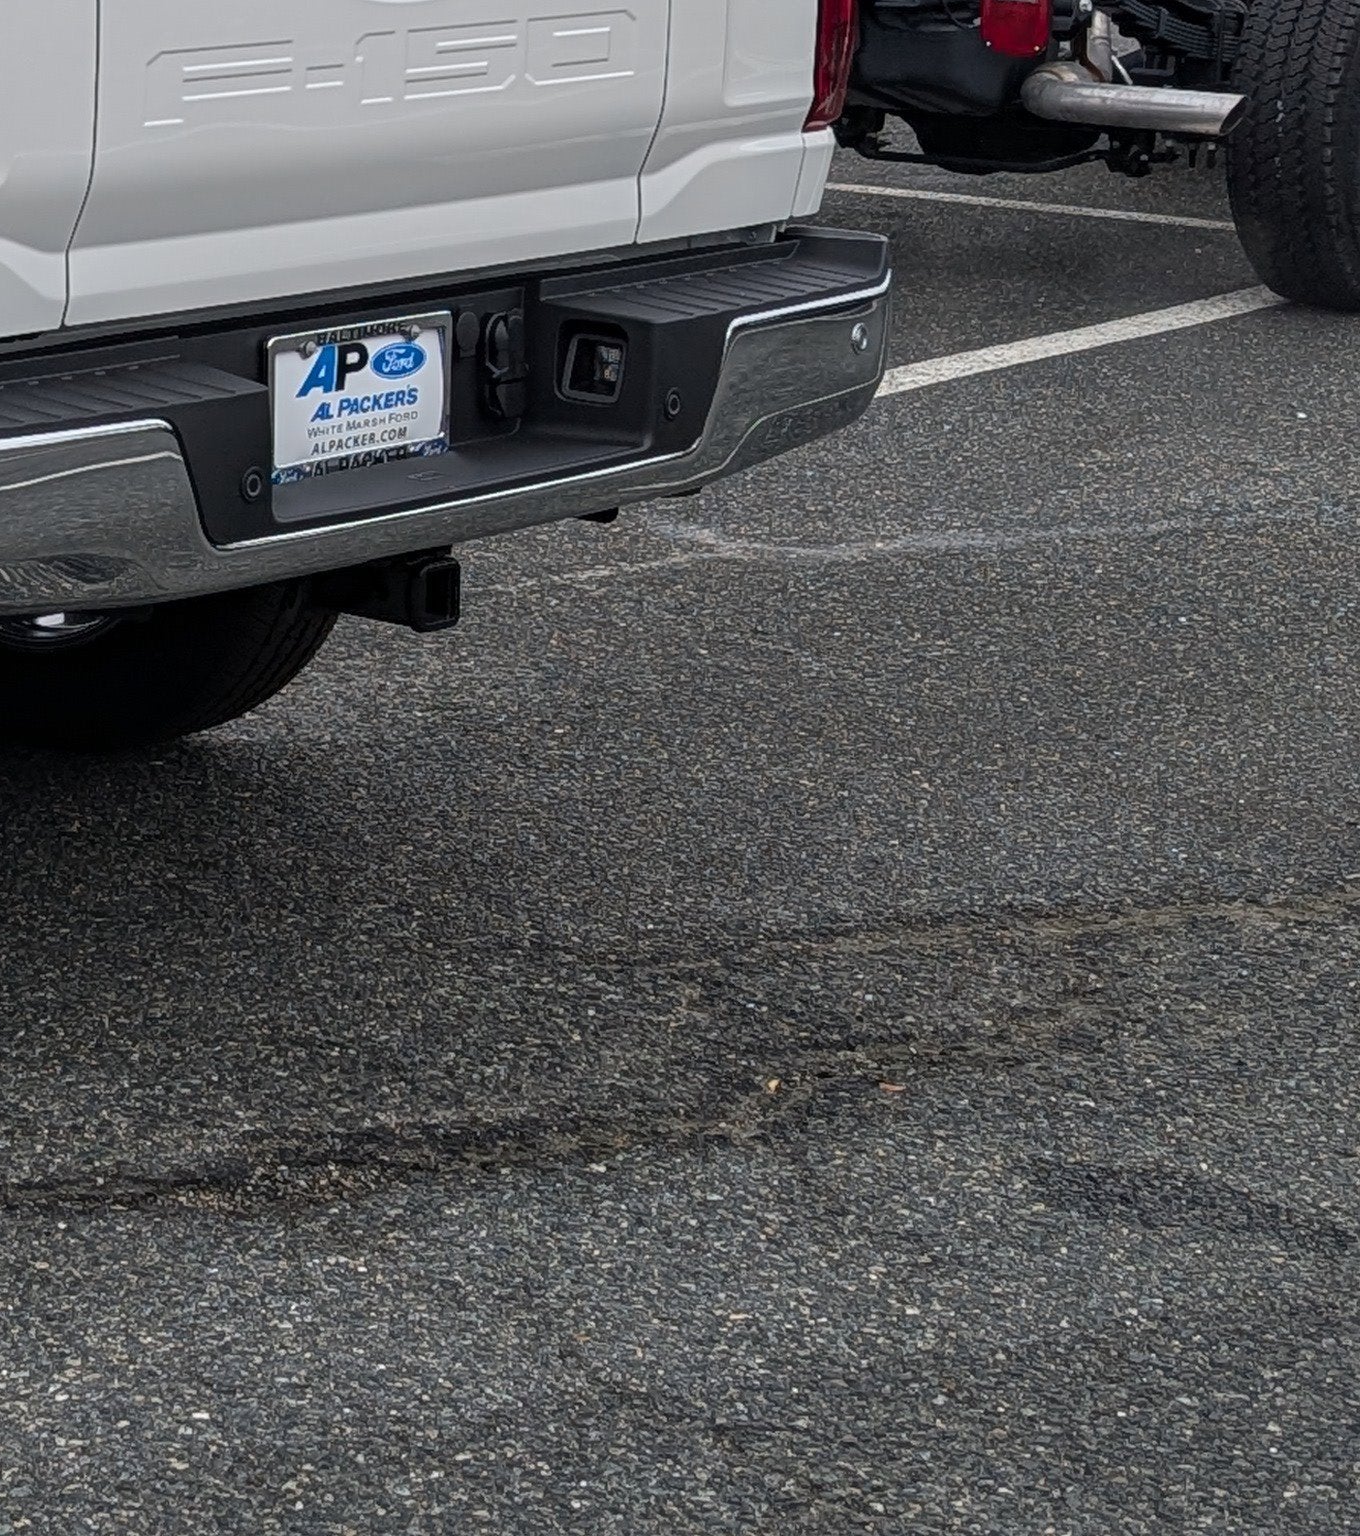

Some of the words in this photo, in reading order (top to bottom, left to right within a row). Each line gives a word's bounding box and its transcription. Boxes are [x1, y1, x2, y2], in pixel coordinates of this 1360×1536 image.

[143, 9, 637, 127] F-150
[295, 342, 369, 398] AP
[310, 402, 334, 422] AL
[337, 384, 419, 417] PACKER'S
[388, 410, 419, 423] FORD
[311, 427, 408, 456] ALPACKER.COM
